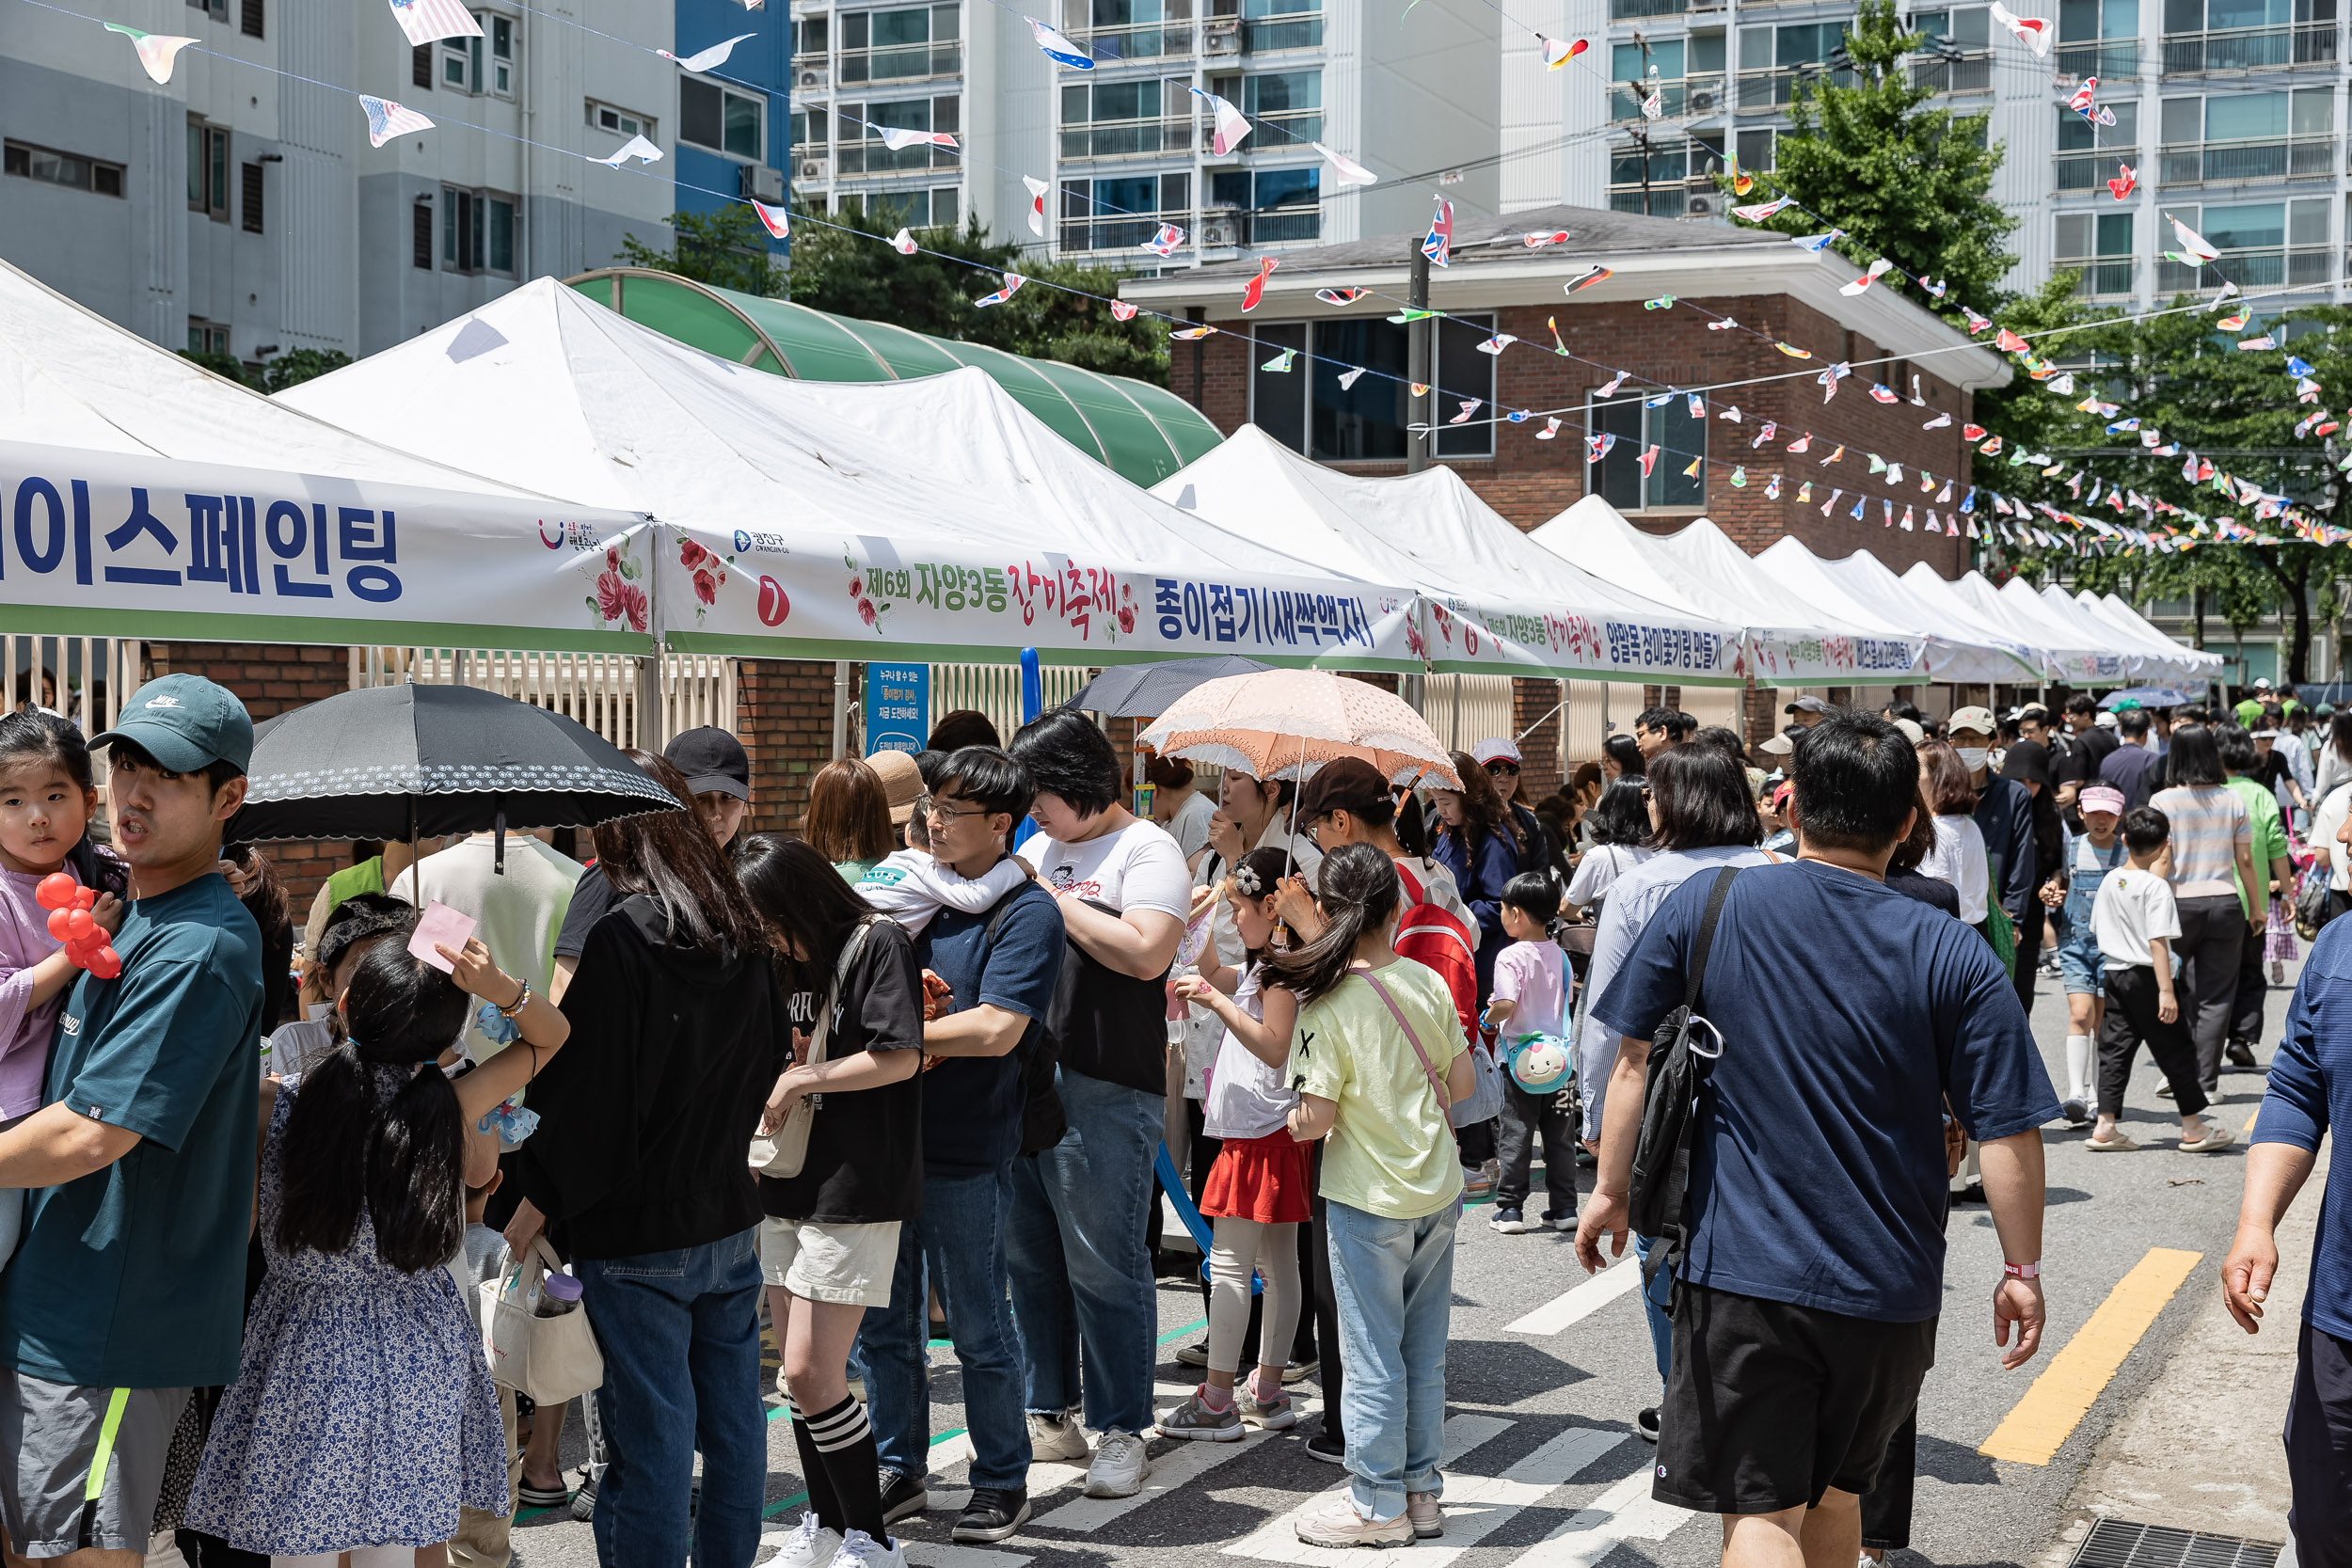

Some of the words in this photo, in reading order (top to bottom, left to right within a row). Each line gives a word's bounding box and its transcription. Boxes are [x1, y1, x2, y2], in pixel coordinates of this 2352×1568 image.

[0, 475, 403, 603] 이스페인팅
[750, 531, 785, 546] 광진구
[766, 579, 780, 622] 7
[866, 567, 911, 599] 제6회
[914, 562, 1009, 613] 자양3동
[1007, 559, 1118, 642] 장미축제
[1154, 578, 1375, 650] 종이접기(새싹액자)
[1487, 617, 1508, 637] 제6회
[1505, 614, 1546, 645] 자양3동
[1543, 610, 1592, 663] 장미축제
[1606, 622, 1641, 664] 양말목
[1641, 626, 1691, 669] 장미꽃키링
[1692, 631, 1723, 670] 만들기
[880, 670, 895, 681] 누구나
[896, 670, 901, 682] 할
[901, 671, 907, 682] 수
[908, 671, 918, 683] 있는
[153, 694, 180, 705] NIKE
[879, 706, 890, 720] 지금
[891, 706, 918, 721] 도전하세요!
